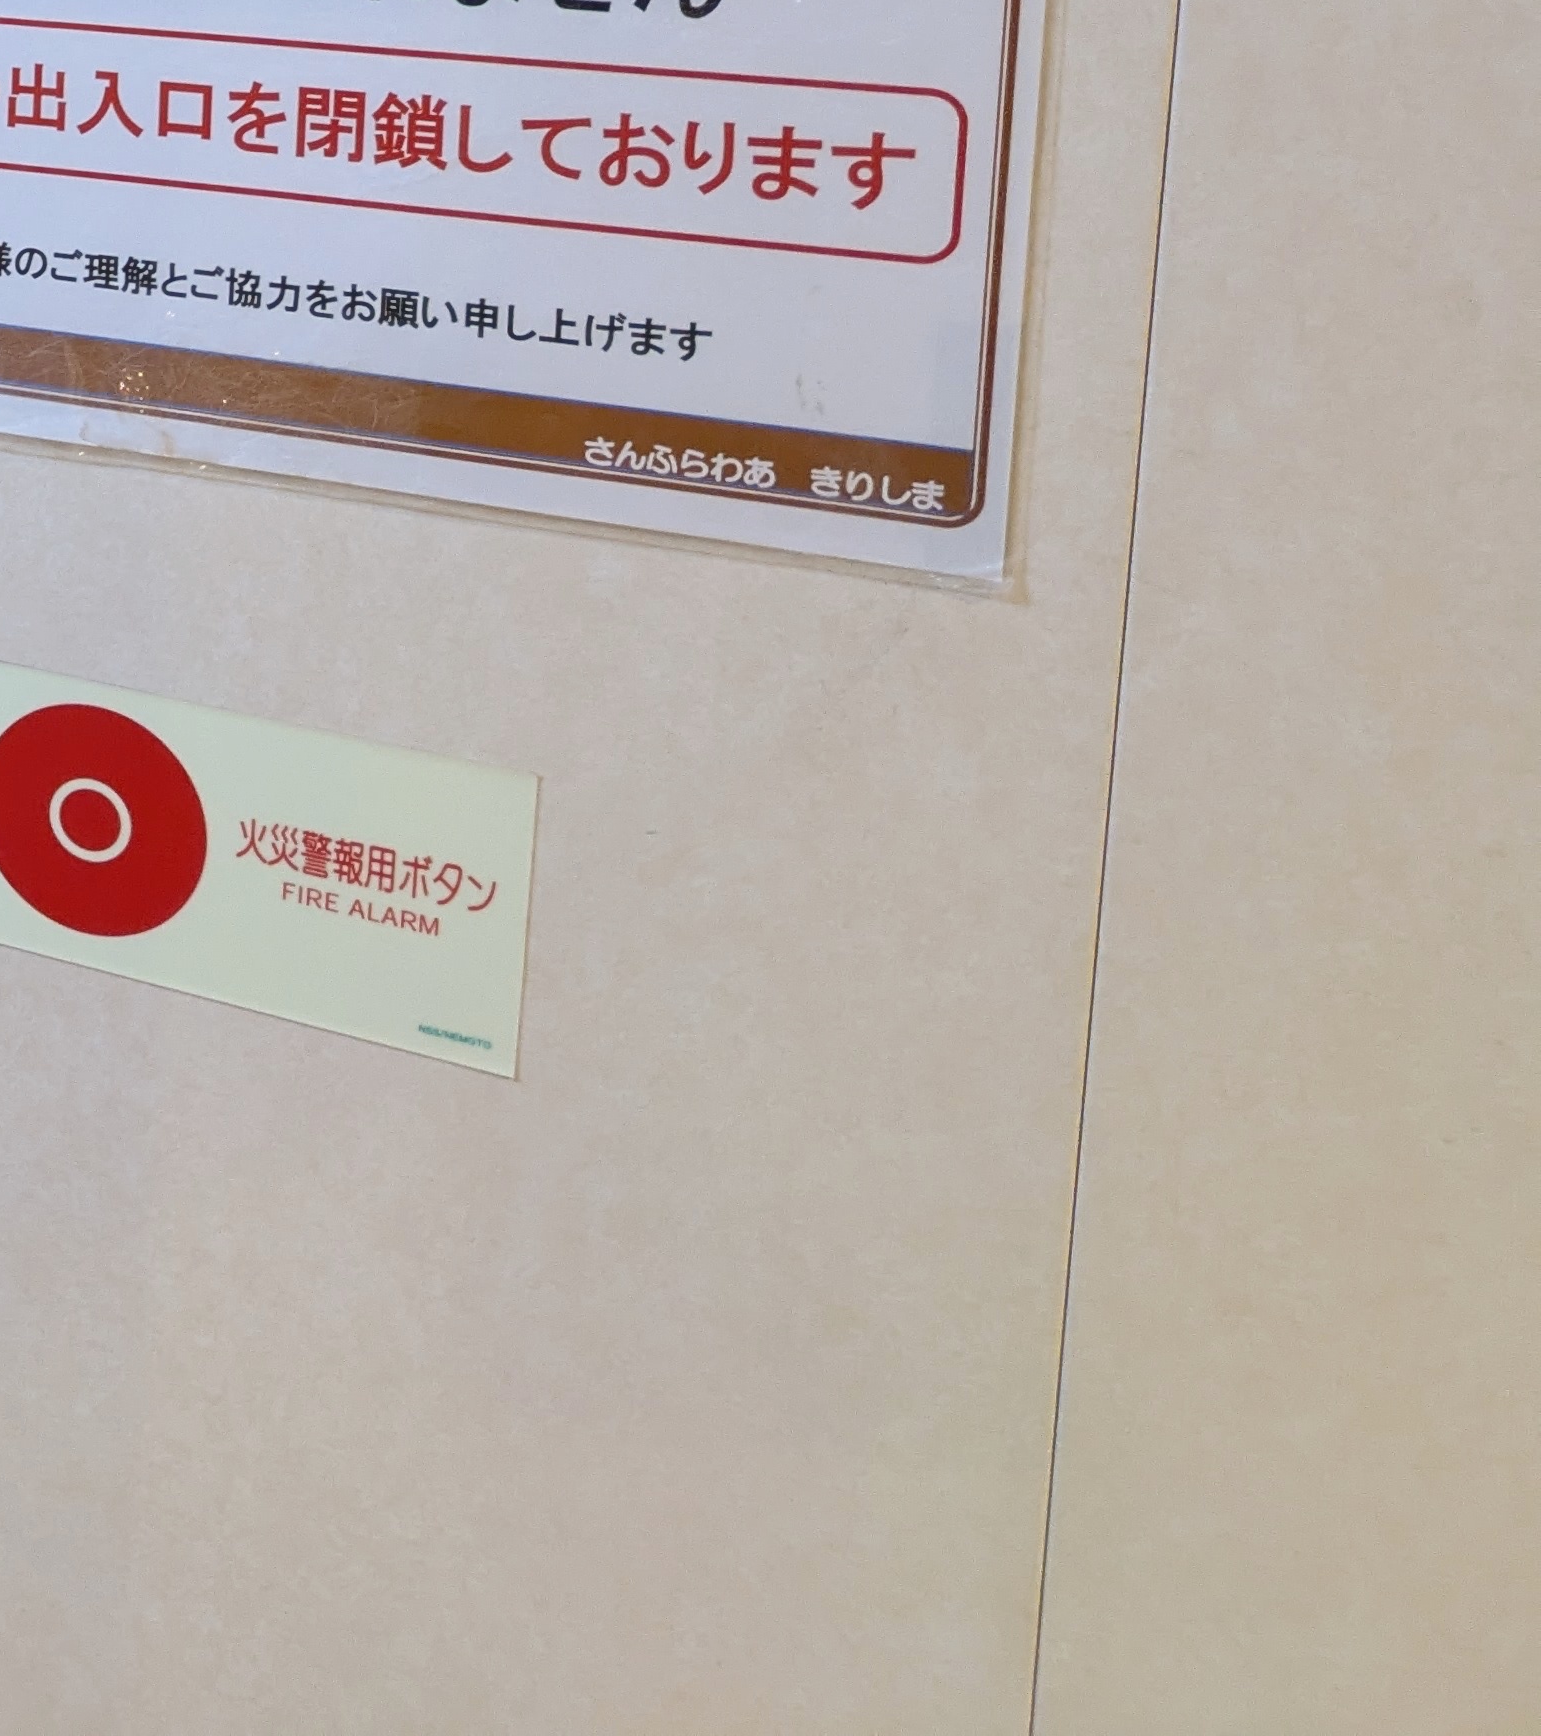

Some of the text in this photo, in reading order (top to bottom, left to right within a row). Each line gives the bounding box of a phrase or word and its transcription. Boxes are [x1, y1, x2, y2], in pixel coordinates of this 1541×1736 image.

[583, 435, 946, 513] さんふらわあ きりしま
[235, 818, 497, 912] 火災警報用ボタン
[281, 881, 440, 937] FIRE ALARM
